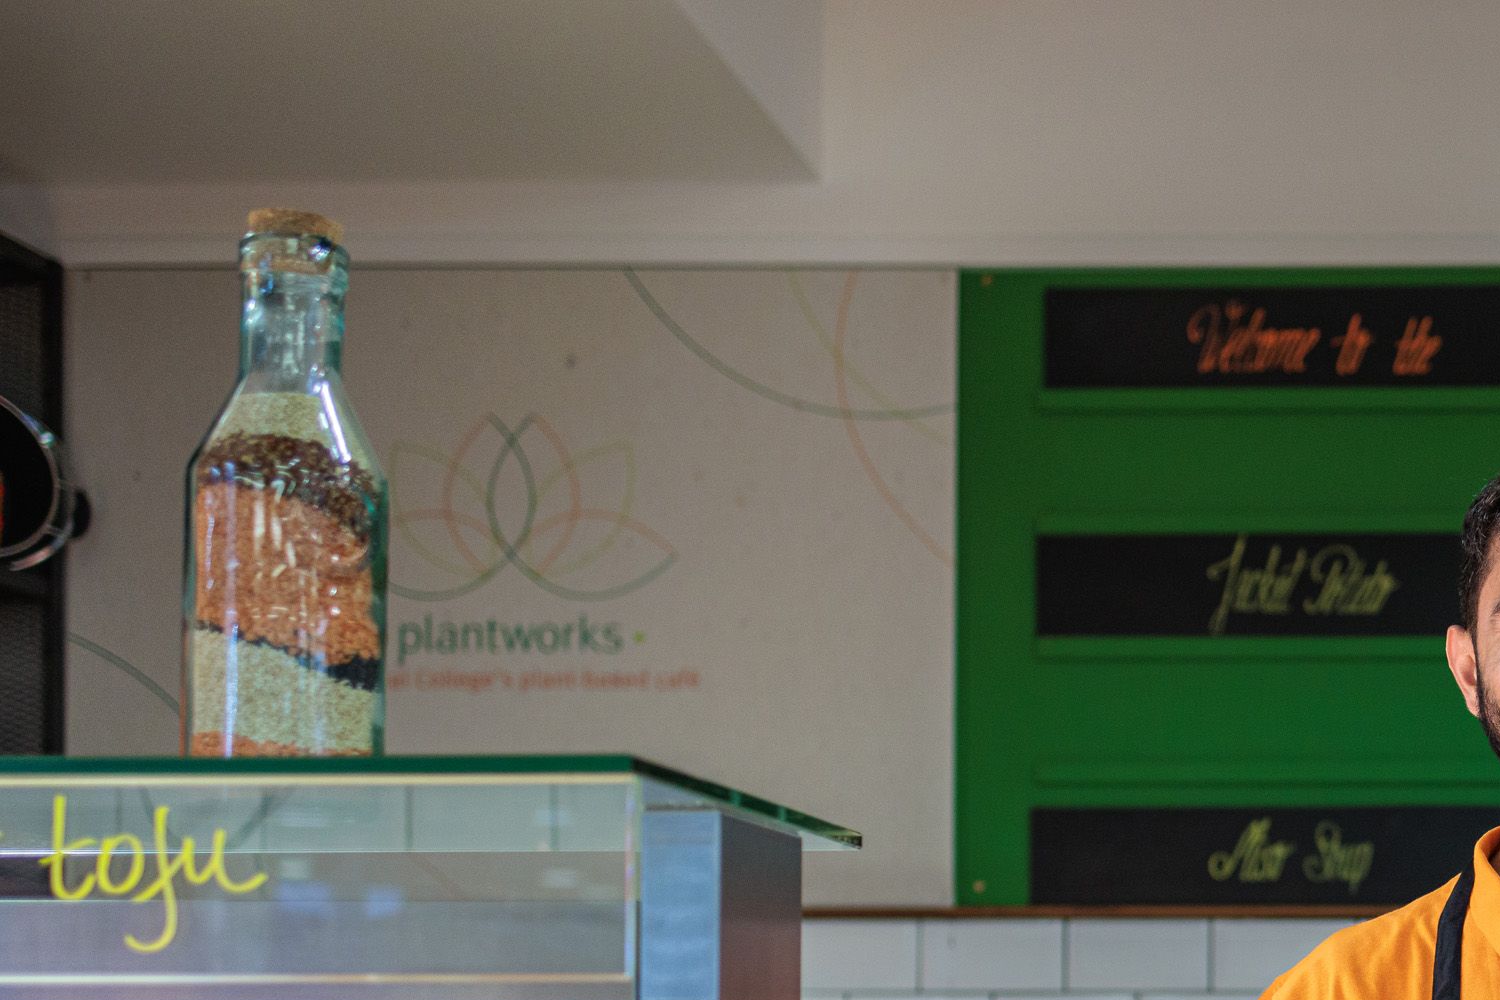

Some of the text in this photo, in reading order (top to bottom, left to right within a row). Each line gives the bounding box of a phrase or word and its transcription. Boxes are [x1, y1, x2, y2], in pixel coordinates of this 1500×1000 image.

[1186, 300, 1443, 376] Welcome to the
[397, 613, 624, 665] plantworks
[38, 795, 269, 954] tofu
